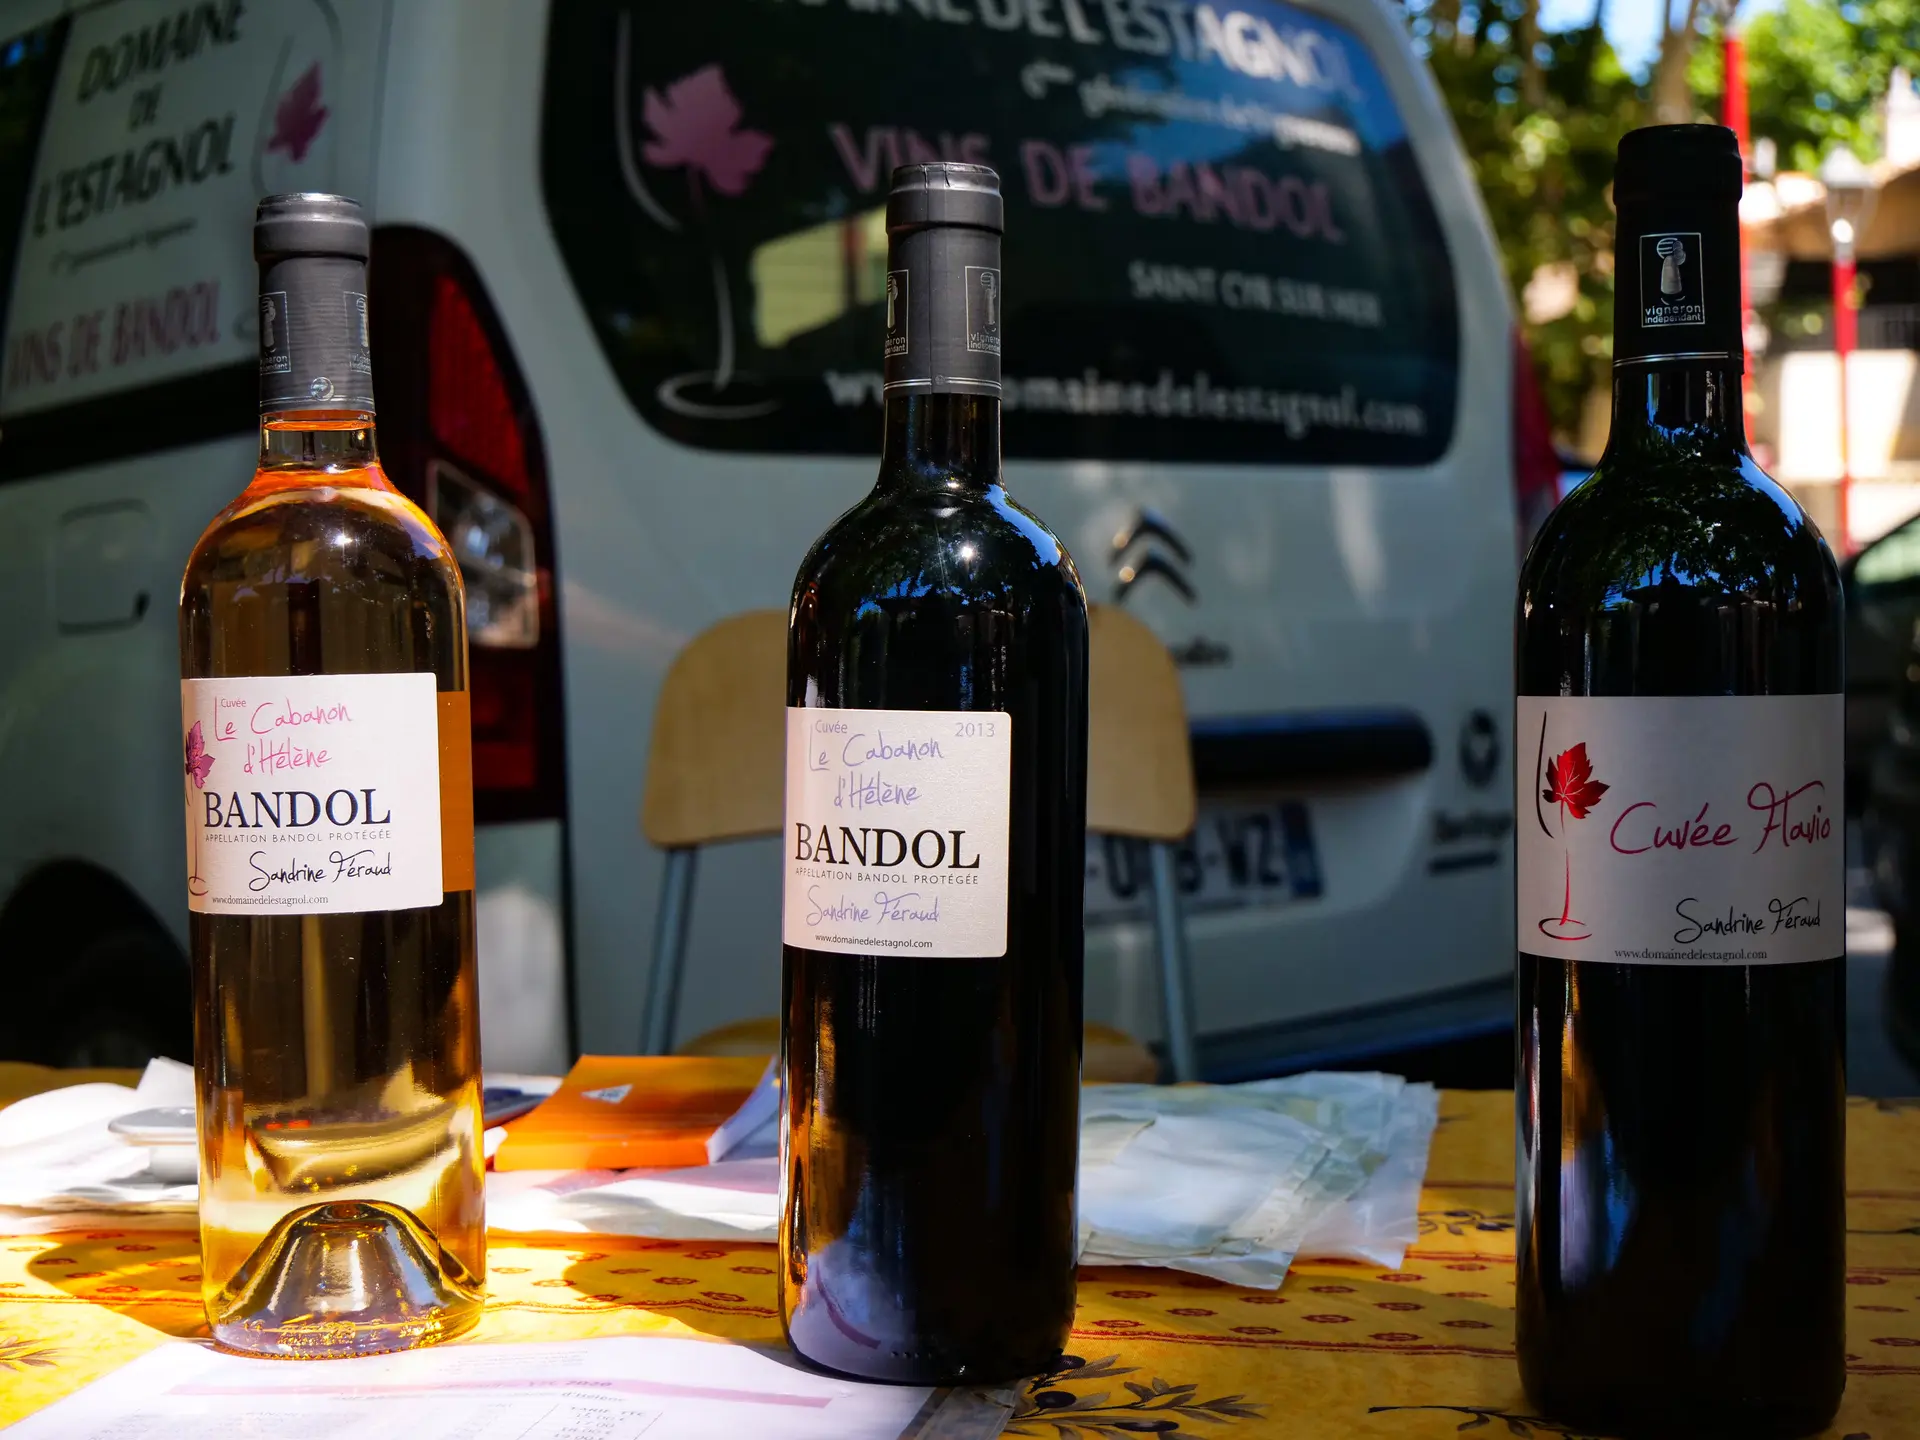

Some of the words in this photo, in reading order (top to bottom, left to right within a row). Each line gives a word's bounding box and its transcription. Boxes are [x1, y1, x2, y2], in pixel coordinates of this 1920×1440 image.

[1020, 140, 1107, 212] DE
[1125, 150, 1348, 245] BANDOL
[1645, 305, 1701, 317] vigneron
[214, 696, 238, 741] Le
[250, 697, 353, 734] Cabanon
[220, 698, 246, 708] Cuvée
[809, 722, 831, 772] Le
[842, 729, 944, 767] Cabanon
[815, 719, 848, 735] Cuvée
[954, 722, 996, 738] 2013
[243, 737, 333, 775] d'Hélène
[203, 788, 391, 828] BANDOL
[833, 770, 922, 810] d'Hélène
[205, 833, 267, 843] APPELLATION
[272, 832, 322, 842] BANDOL
[329, 829, 392, 841] PROTÉGÉE
[1610, 801, 1740, 855] Cuvée
[1747, 780, 1831, 855] Flavio
[795, 822, 981, 869] BANDOL
[249, 850, 327, 892] Sandrine
[329, 849, 392, 883] Féraud
[795, 867, 852, 881] APPELLATION
[857, 872, 908, 884] BANDOL
[914, 873, 978, 885] PROTÉGÉE
[212, 894, 329, 908] www.domainedelestagnol.com
[806, 884, 872, 926] Sandrine
[874, 891, 941, 925] Féraud
[1674, 897, 1766, 944] Sandrine
[1768, 896, 1821, 935] Féraud
[815, 934, 933, 949] www.domainedelestagnol.com
[1614, 948, 1768, 963] www.domainedelestagnol.com
